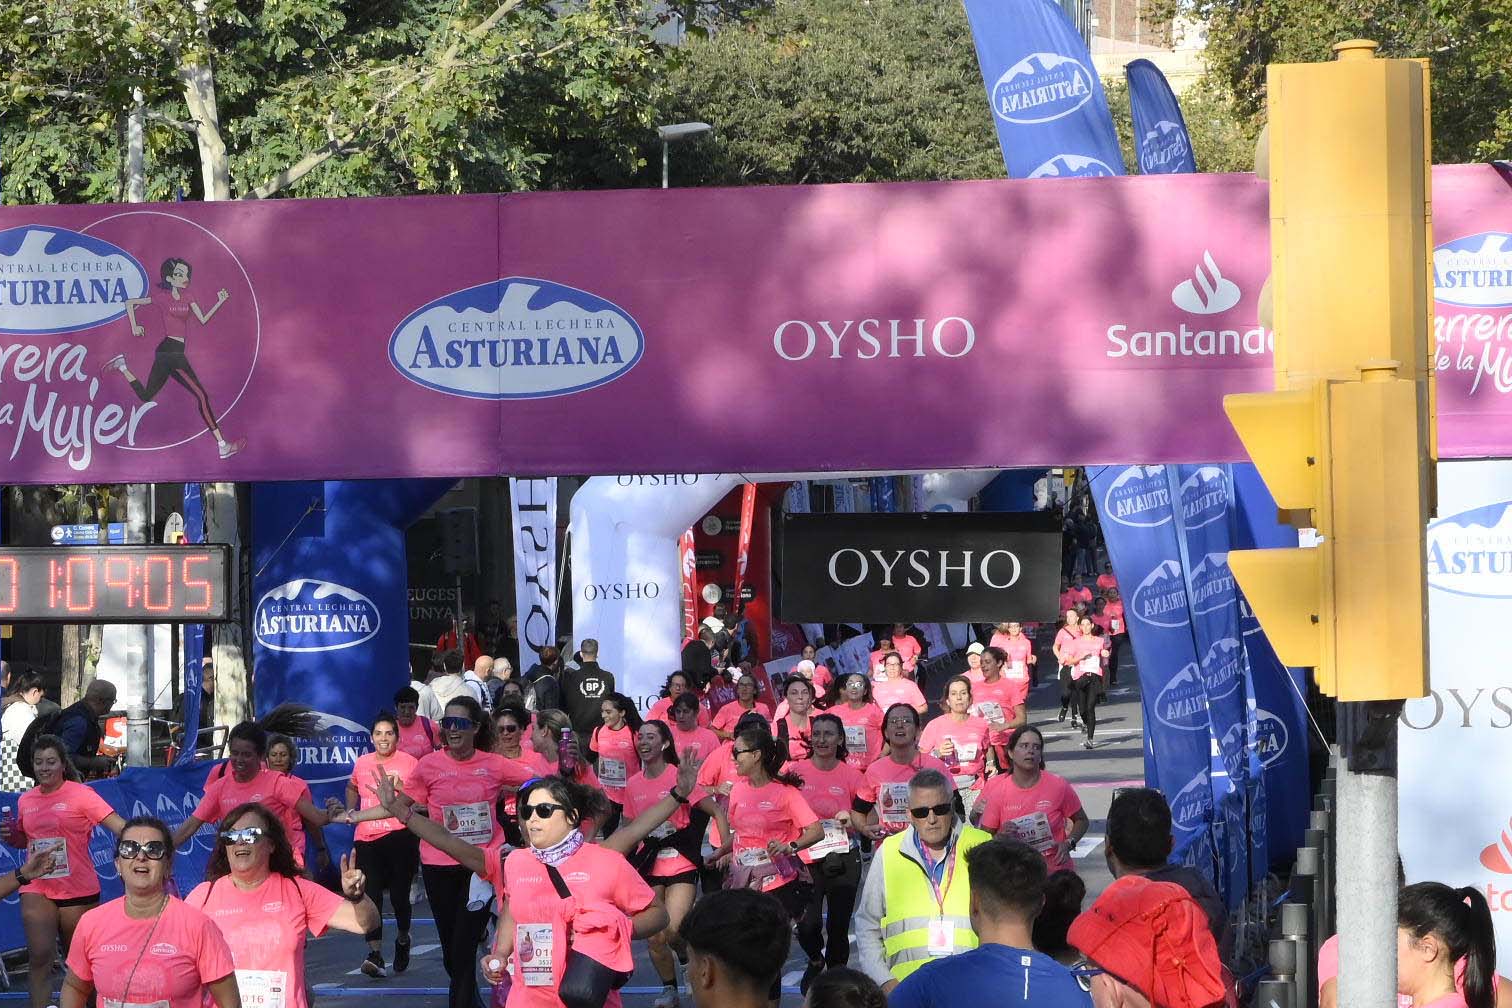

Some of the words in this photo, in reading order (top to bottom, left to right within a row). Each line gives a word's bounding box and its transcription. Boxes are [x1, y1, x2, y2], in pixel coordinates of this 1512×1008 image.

[50, 261, 123, 273] LECHERA
[448, 320, 526, 333] CENTRAL
[534, 317, 615, 331] LECHERA
[773, 316, 976, 361] OYSHO
[408, 325, 624, 369] ASTURIANA
[9, 376, 157, 470] Mujer
[828, 548, 1021, 589] OYSHO
[584, 582, 659, 602] OYSHO
[259, 608, 371, 636] ASTURIANA
[272, 603, 314, 613] CENTRAL
[318, 603, 367, 612] LECHERA
